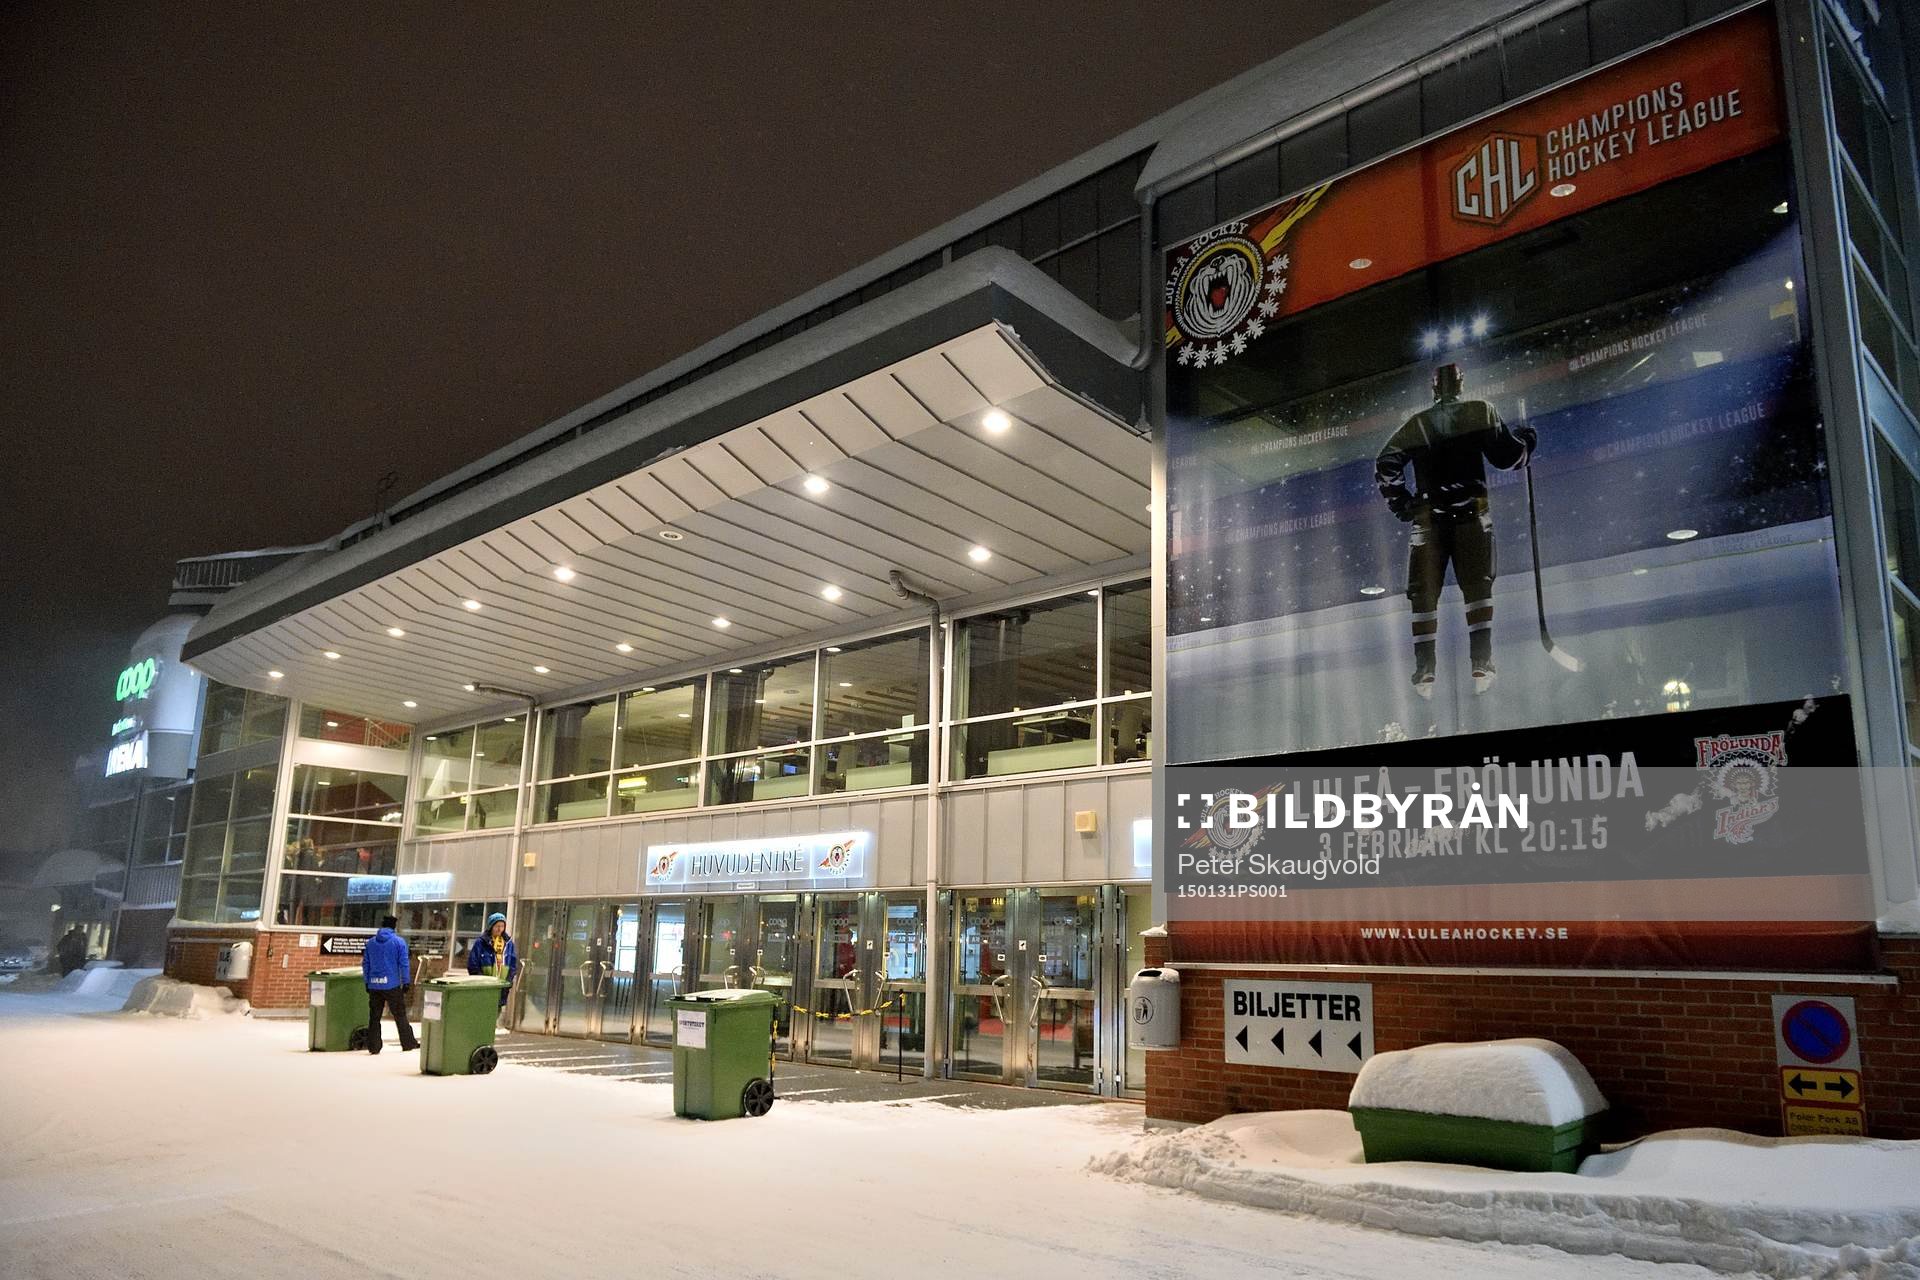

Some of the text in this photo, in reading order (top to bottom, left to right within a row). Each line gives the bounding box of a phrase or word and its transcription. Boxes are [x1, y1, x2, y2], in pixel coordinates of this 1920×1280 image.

[1546, 81, 1684, 155] CHAMPIONS
[1549, 89, 1743, 183] HOCKEY LEAGUE
[1457, 138, 1535, 218] CHL
[1188, 222, 1249, 254] HOCKEY
[1579, 339, 1630, 370] CHAMPIONS
[1631, 327, 1668, 350] HOCKEY
[1669, 312, 1708, 338] LEAGUE
[1718, 401, 1766, 430] LEAGUE
[1261, 435, 1298, 454] CHAMPIONS
[1299, 431, 1323, 446] HOCKEY
[1324, 424, 1349, 440] LEAGUE
[116, 658, 156, 702] coop
[1695, 731, 1786, 769] FRÖLUNDA
[1434, 751, 1645, 811] FRÖLUNDA
[1319, 832, 1332, 861] 3
[1475, 822, 1509, 855] KL
[1520, 814, 1609, 853] 20:15
[1361, 927, 1569, 940] WWW.LULEAHOCKEY.SE
[1233, 990, 1361, 1022] BILJETTER
